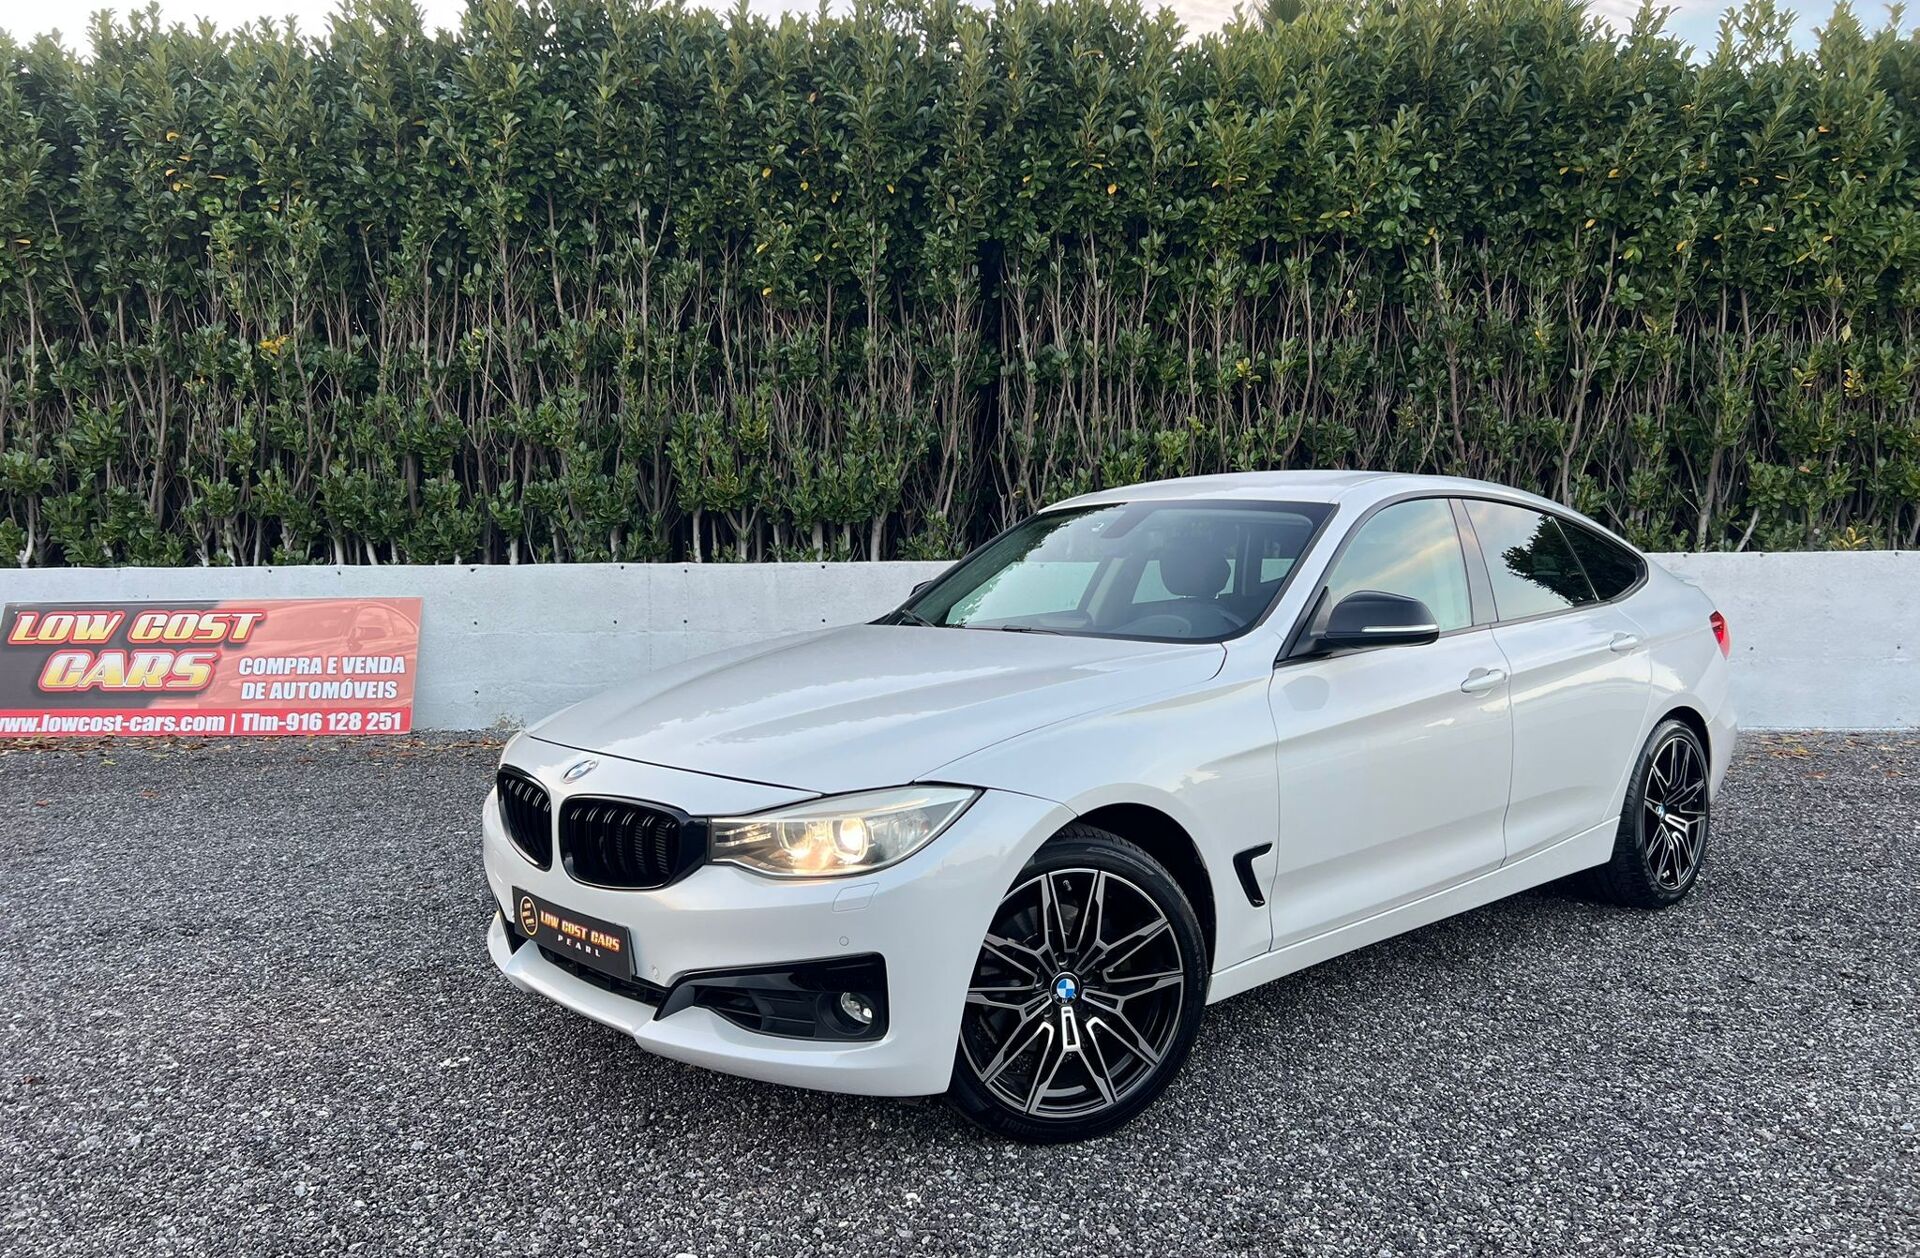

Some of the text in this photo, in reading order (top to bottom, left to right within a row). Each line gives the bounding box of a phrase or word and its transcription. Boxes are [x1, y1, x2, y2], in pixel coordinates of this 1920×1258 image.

[9, 611, 265, 643] LOW COST
[41, 651, 220, 689] CARS
[238, 656, 406, 675] COMPRA E VENDA
[241, 678, 398, 700] DE AUTOMÓVEIS
[0, 713, 225, 733] ww.lowcost-cars.com
[241, 712, 323, 731] Tlm-916
[327, 712, 362, 731] 128
[366, 712, 401, 731] 251
[540, 910, 559, 929] LOW
[561, 920, 588, 940] COST
[591, 930, 620, 952] CARS
[557, 934, 601, 957] PEARL
